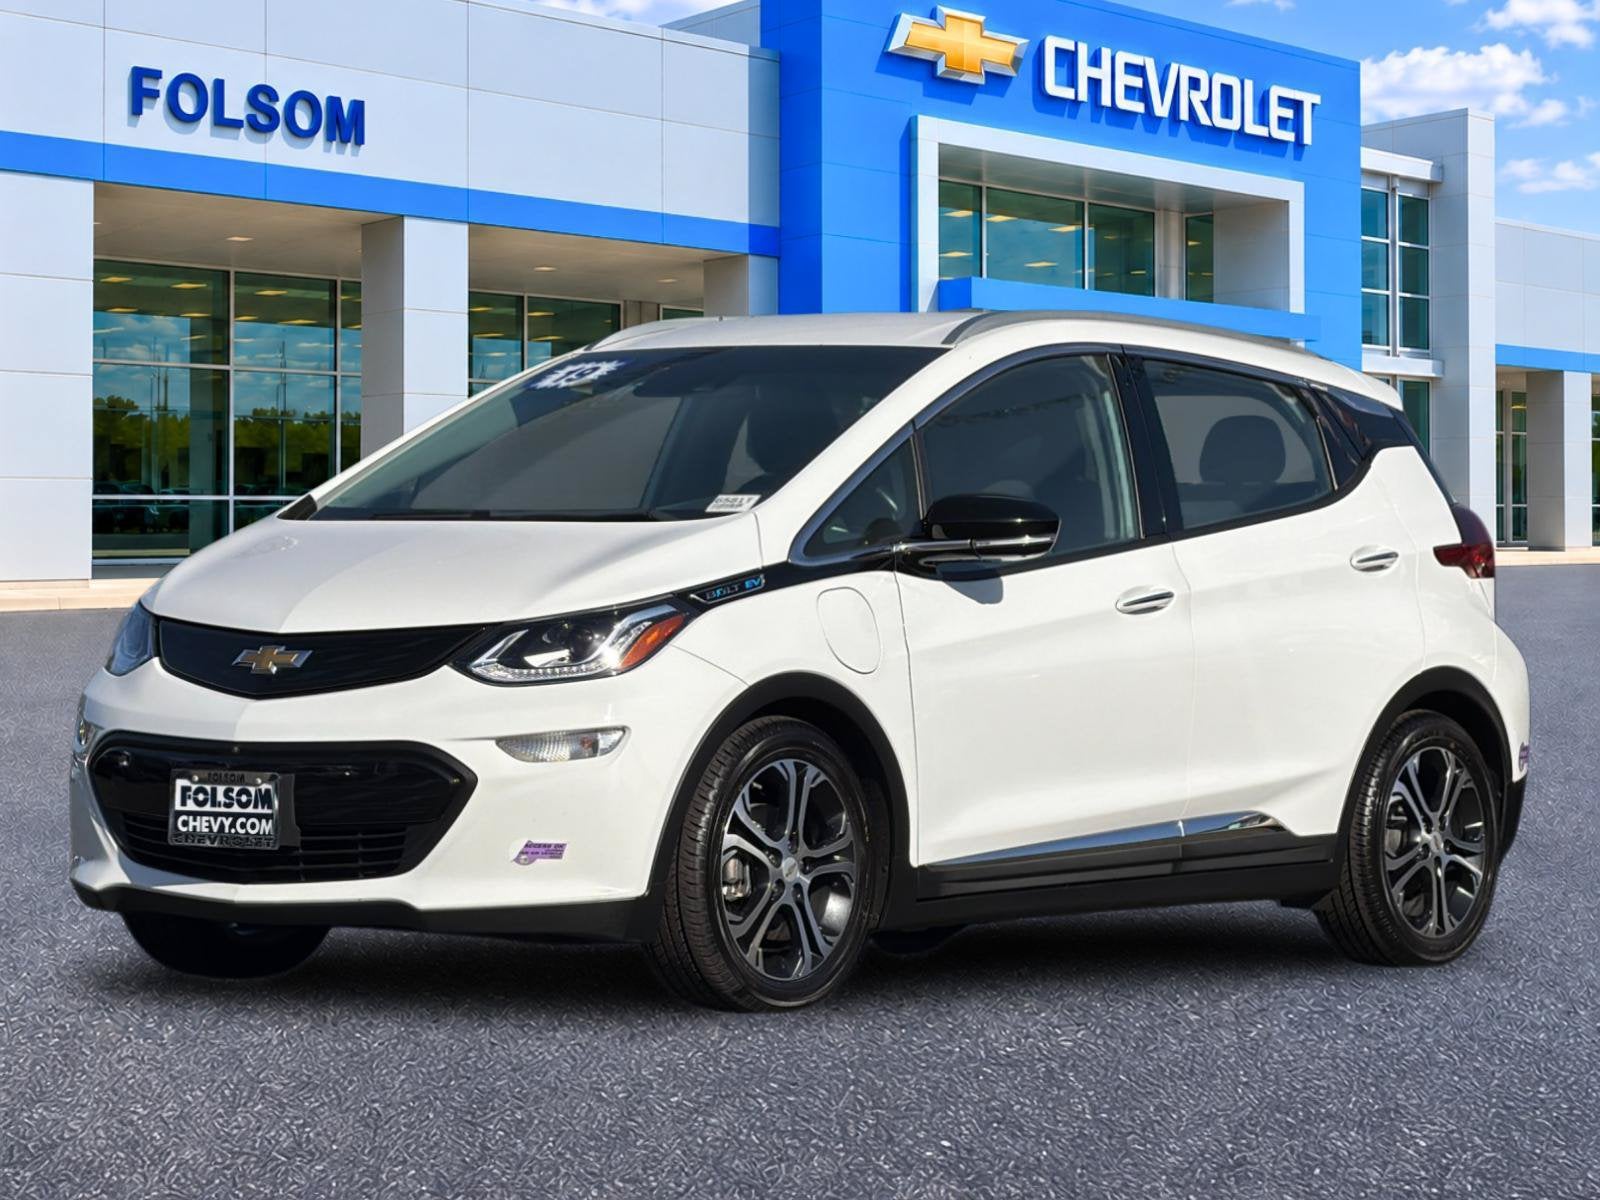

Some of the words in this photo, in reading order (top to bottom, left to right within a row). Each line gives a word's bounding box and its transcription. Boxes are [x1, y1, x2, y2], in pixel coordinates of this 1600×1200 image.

[1043, 34, 1322, 146] CHEVROLET
[130, 65, 366, 147] FOLSOM
[706, 584, 739, 600] BOLT
[744, 578, 761, 589] EV
[207, 772, 246, 784] FOLSOM
[180, 785, 273, 810] FOLSOM
[177, 814, 274, 835] CHEVY.COM
